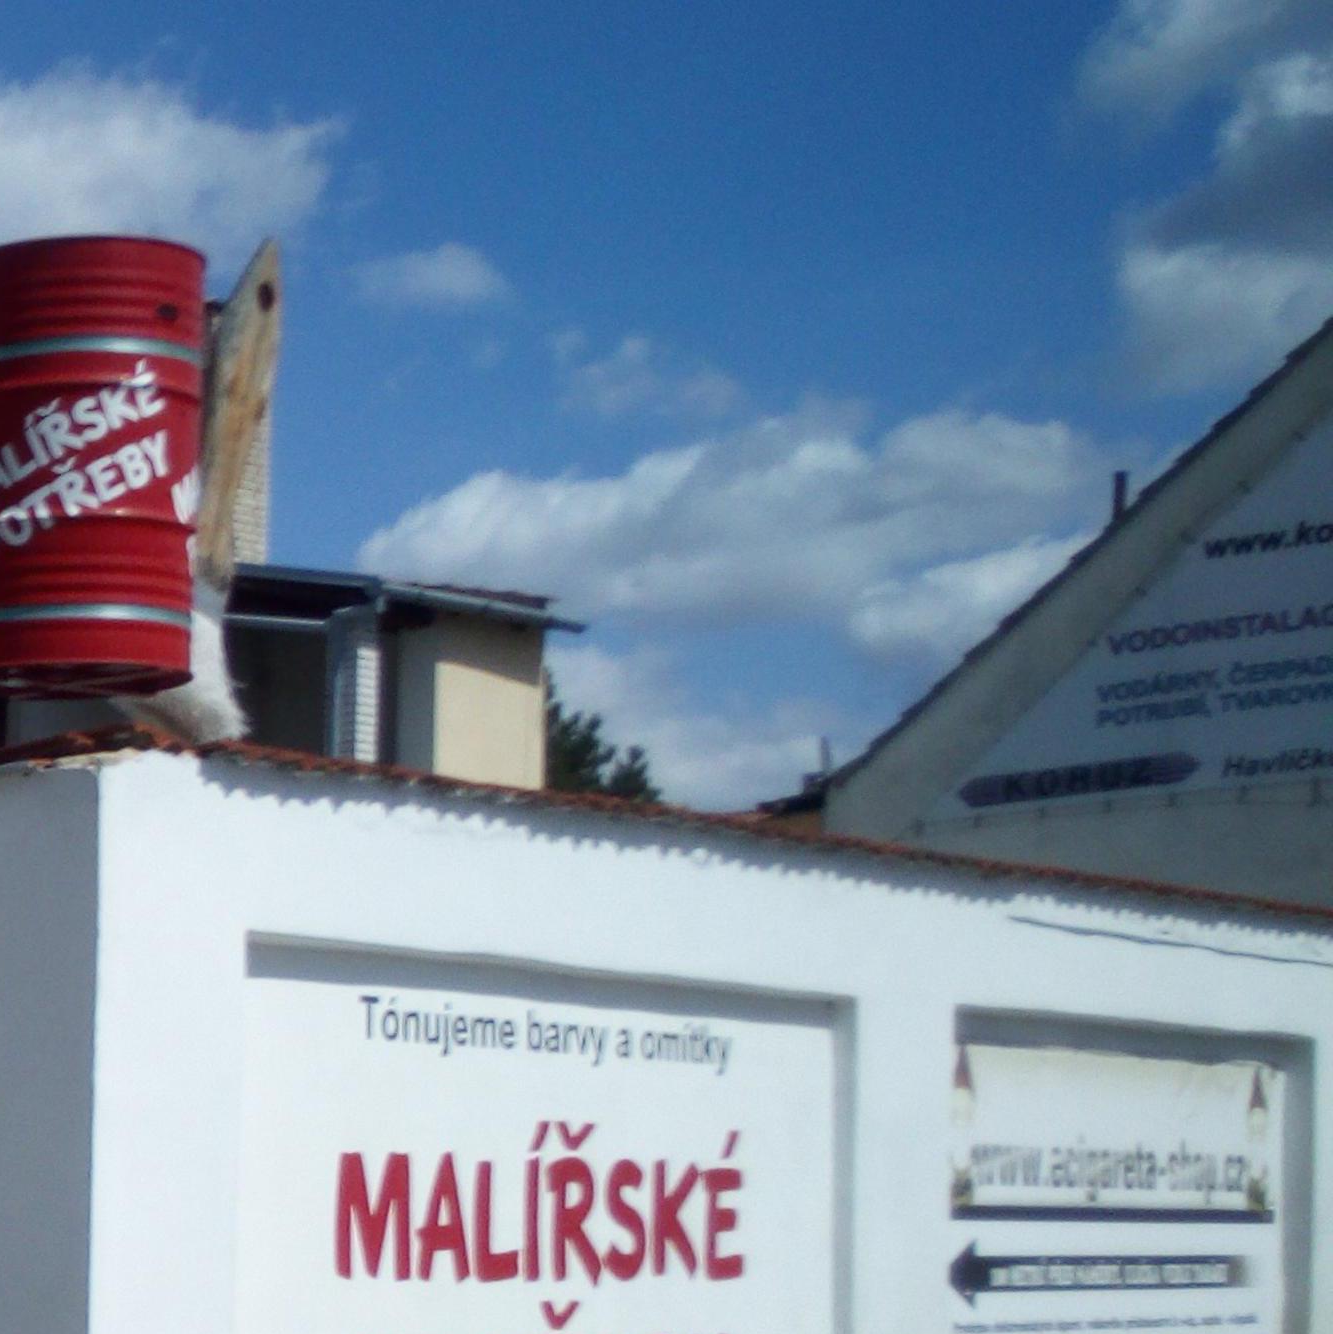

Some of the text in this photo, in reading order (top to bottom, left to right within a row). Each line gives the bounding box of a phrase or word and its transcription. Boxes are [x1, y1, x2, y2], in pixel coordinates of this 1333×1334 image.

[359, 995, 732, 1076] Tónujeme barvy a omítky
[333, 1119, 745, 1287] MALÍŘSKÉ
